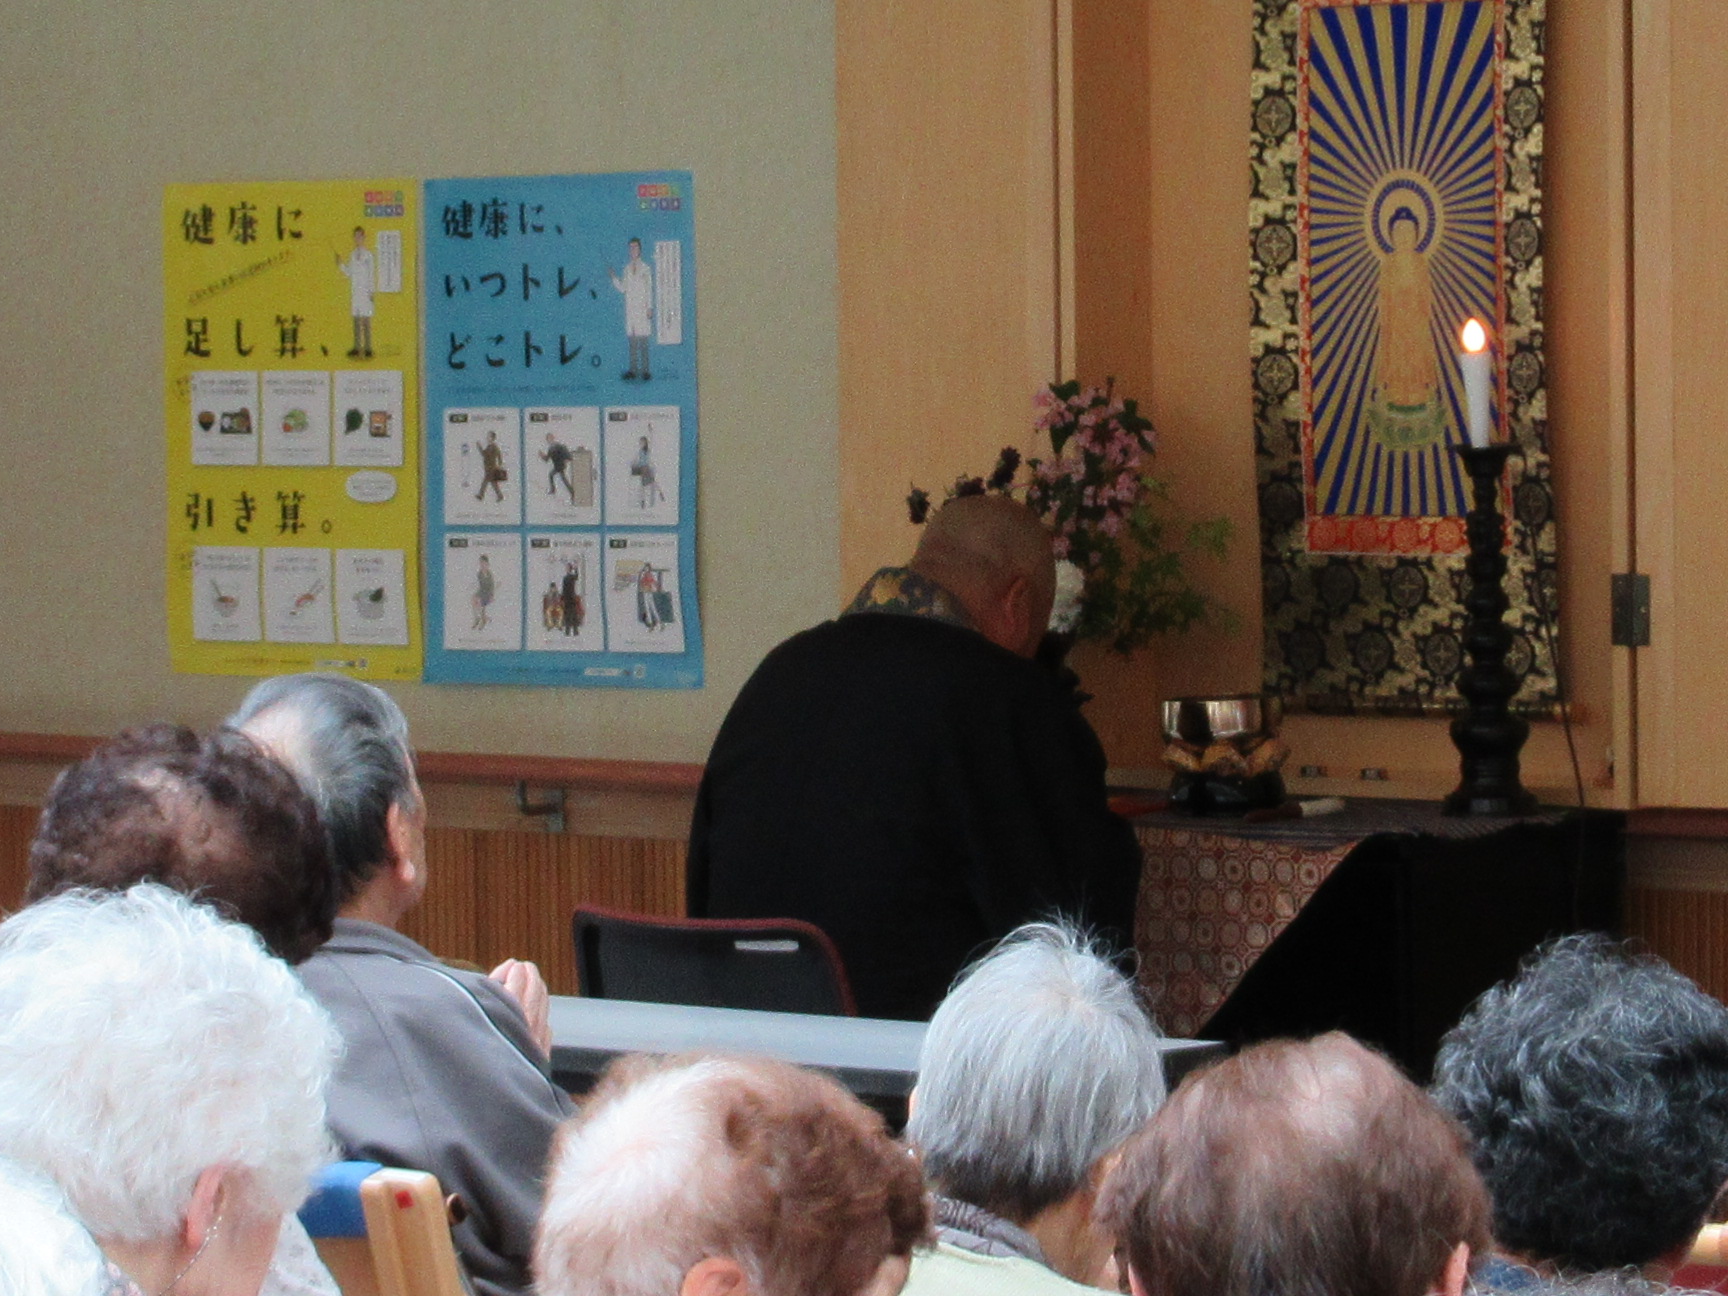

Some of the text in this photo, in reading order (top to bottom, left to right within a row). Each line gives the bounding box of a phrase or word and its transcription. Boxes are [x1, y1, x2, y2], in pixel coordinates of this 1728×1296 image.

[181, 201, 304, 245] 健康に
[442, 196, 564, 240] 健康に、
[445, 263, 598, 301] いつトレ、
[184, 315, 329, 359] 足し算、
[448, 330, 602, 370] どこトレ。
[186, 490, 333, 535] 引き算。
